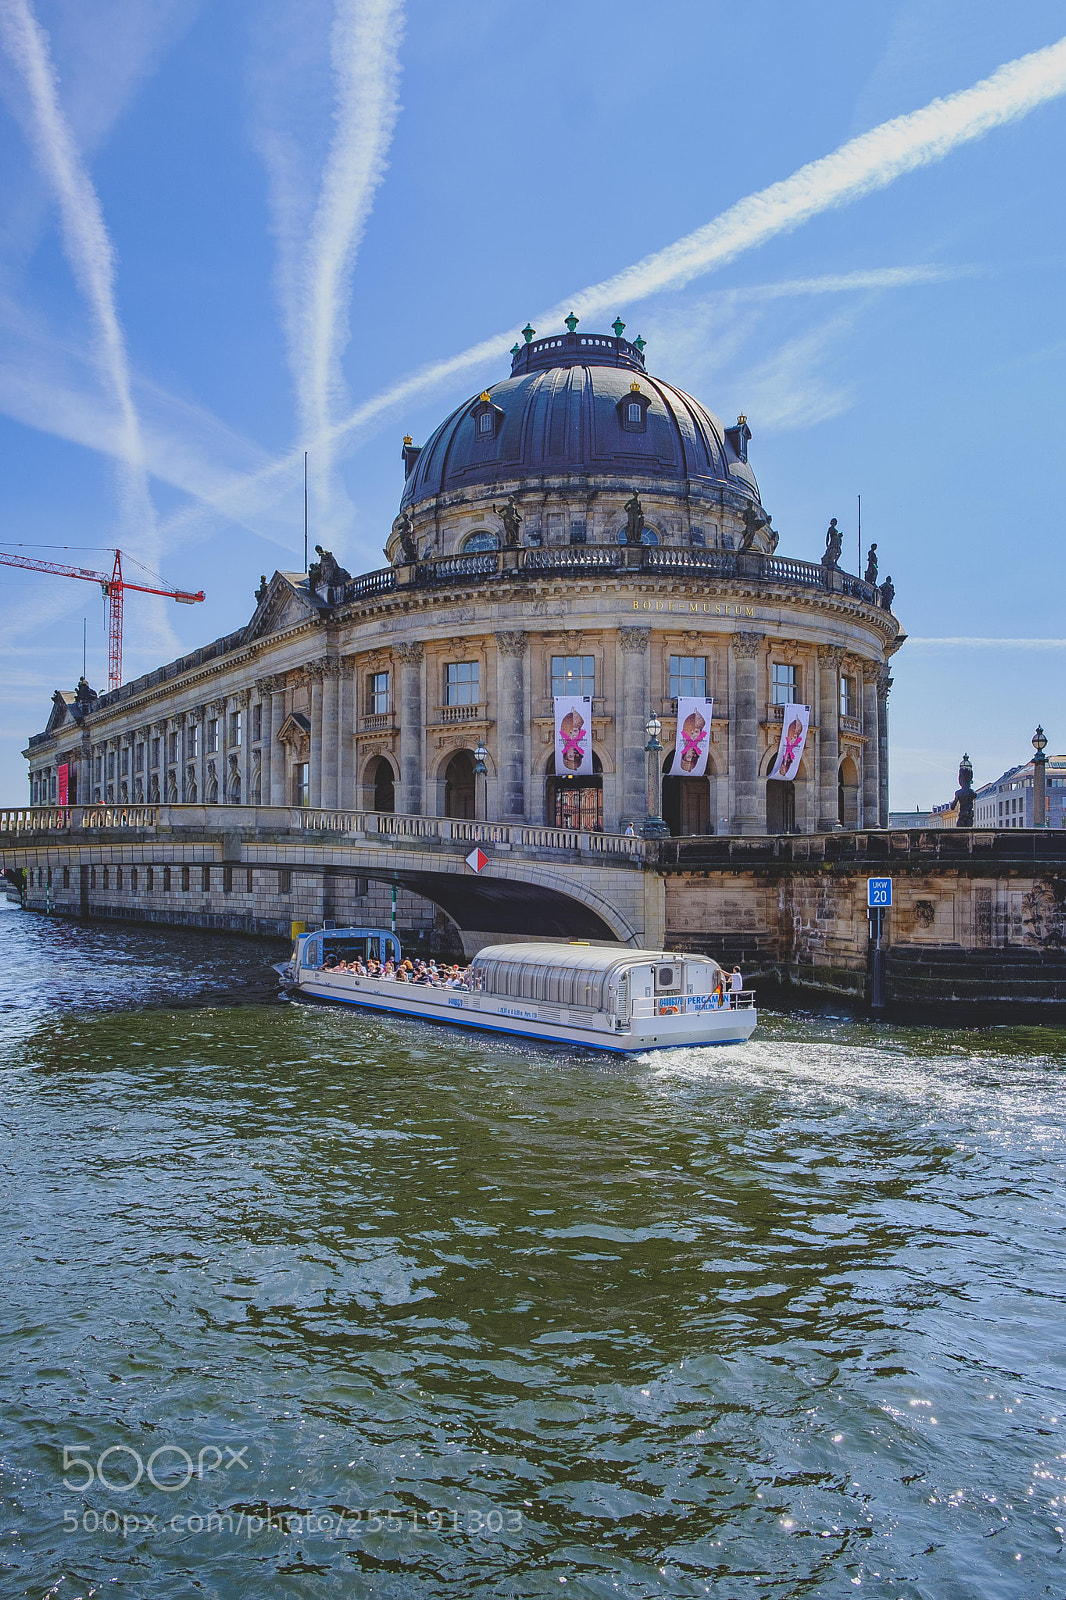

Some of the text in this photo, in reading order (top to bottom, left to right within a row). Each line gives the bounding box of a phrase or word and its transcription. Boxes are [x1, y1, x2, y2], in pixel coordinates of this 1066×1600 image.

[632, 600, 754, 616] BODE-MUSEUM
[872, 881, 888, 889] UKW
[873, 890, 887, 903] 20
[687, 994, 729, 1005] PERGAMN
